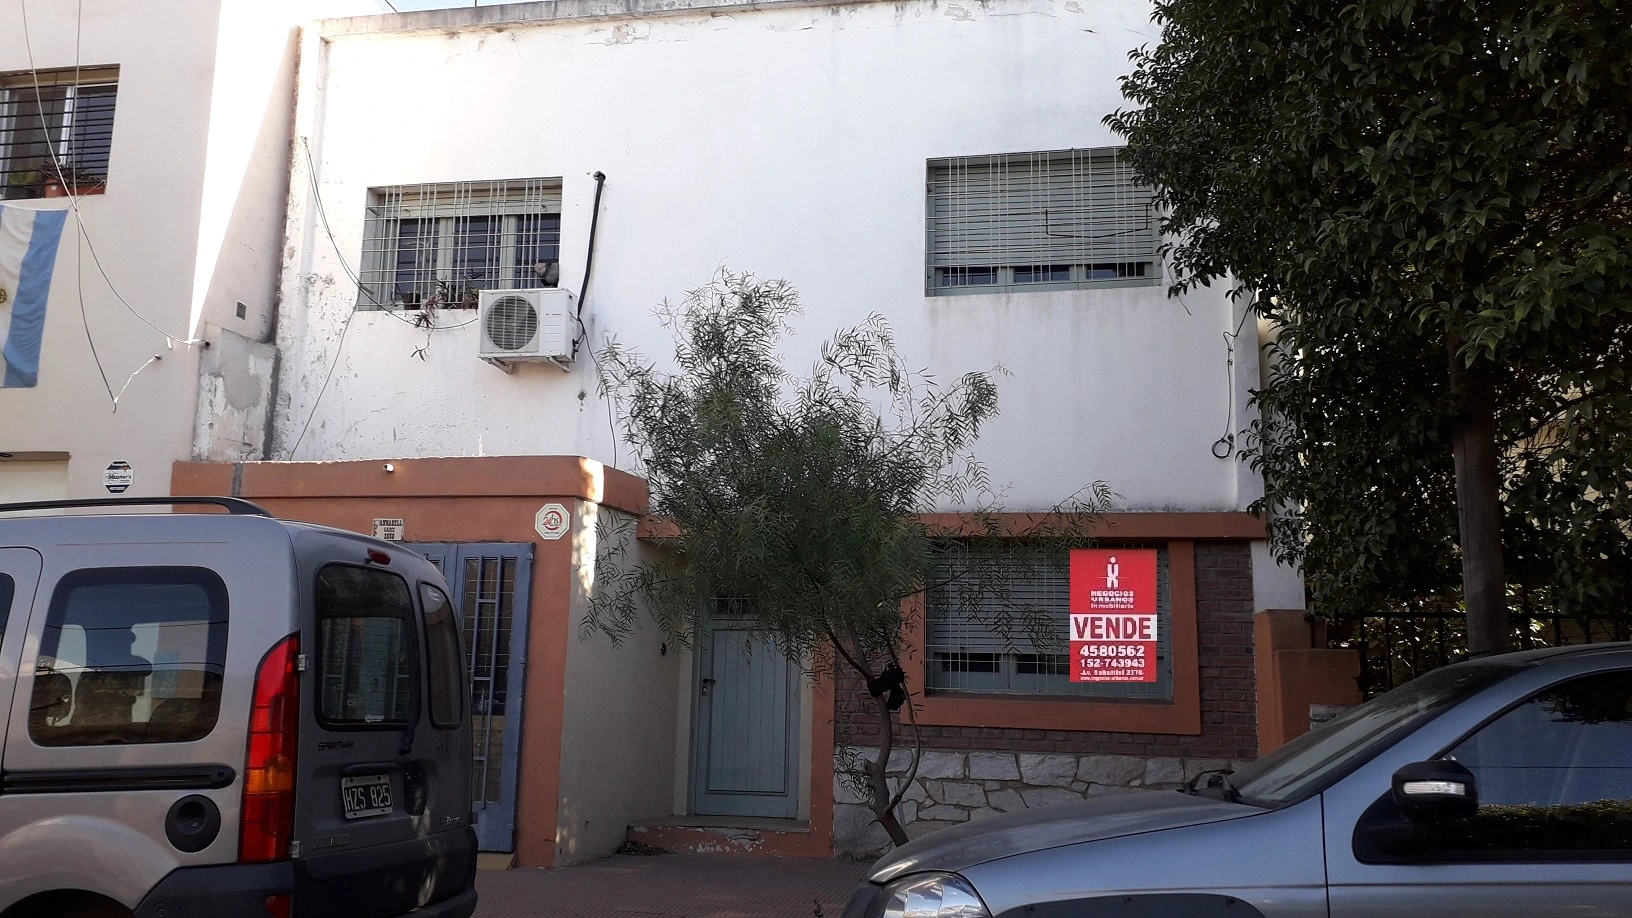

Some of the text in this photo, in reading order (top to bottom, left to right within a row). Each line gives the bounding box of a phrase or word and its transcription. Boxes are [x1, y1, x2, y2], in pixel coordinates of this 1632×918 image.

[1074, 617, 1151, 639] VENDE
[1079, 645, 1145, 657] 4580562
[1080, 659, 1145, 668] 152-743943
[345, 784, 391, 813] HZS 825
